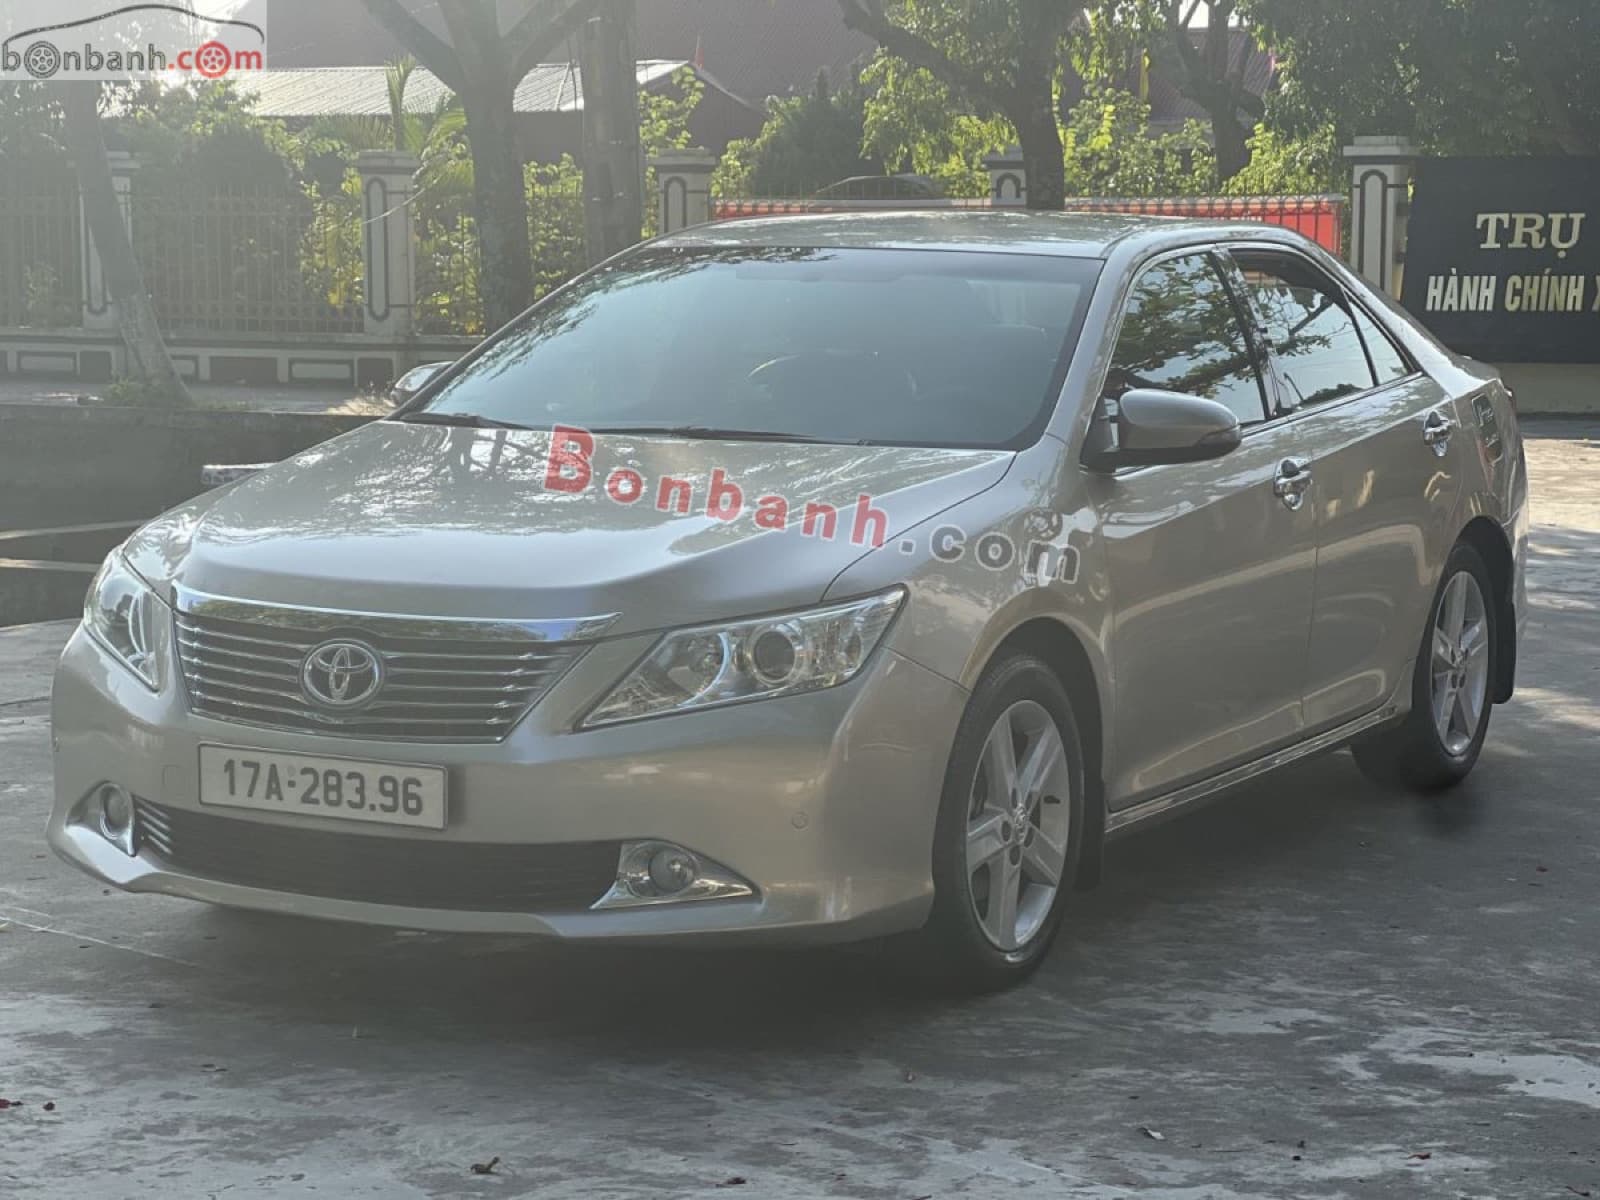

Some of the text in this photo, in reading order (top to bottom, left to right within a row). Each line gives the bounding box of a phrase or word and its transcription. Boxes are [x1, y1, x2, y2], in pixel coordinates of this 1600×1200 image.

[1475, 212, 1586, 259] TRỤ
[1425, 267, 1497, 312] HÀNH
[1504, 267, 1585, 312] CHÍNH
[223, 758, 424, 816] 17A-283.96
